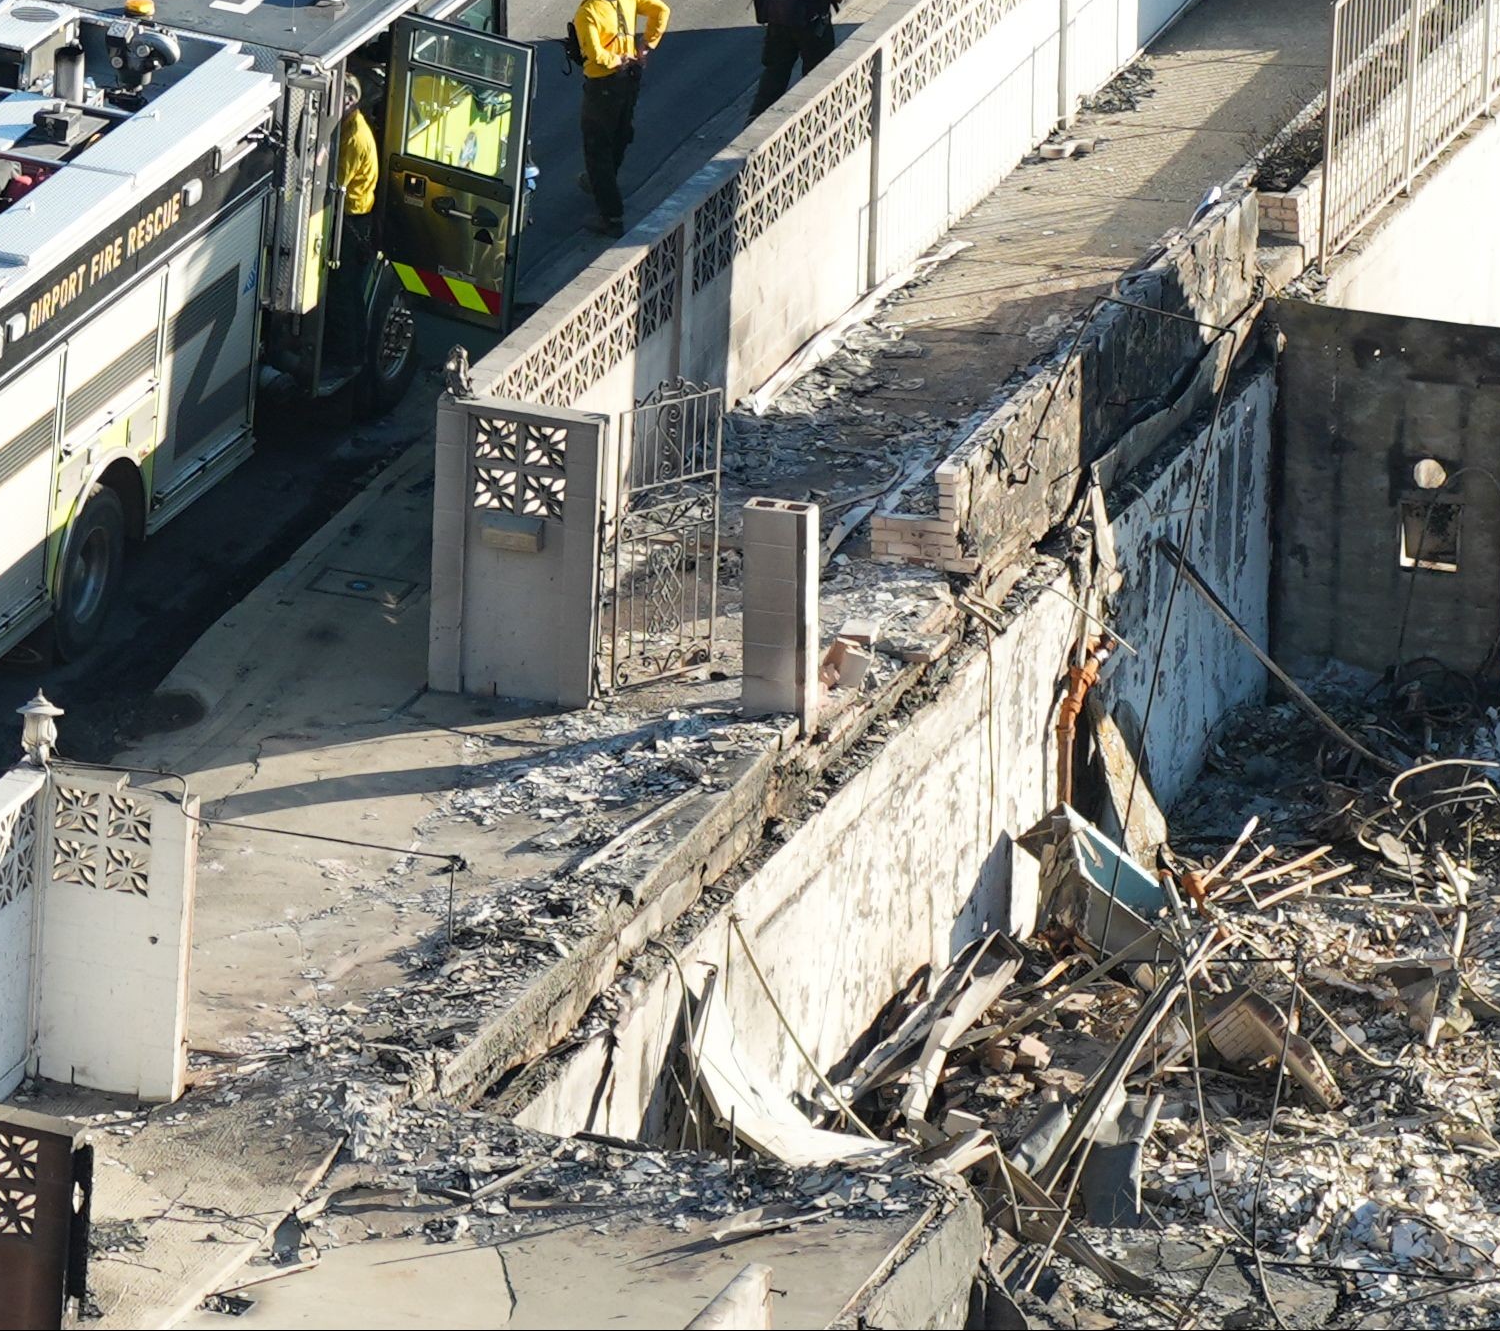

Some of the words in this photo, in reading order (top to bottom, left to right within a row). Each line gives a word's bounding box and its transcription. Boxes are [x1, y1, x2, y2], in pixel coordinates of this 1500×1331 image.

[27, 263, 88, 334] AIRPORT
[89, 236, 124, 288] FIRE
[126, 192, 182, 260] RESCUE
